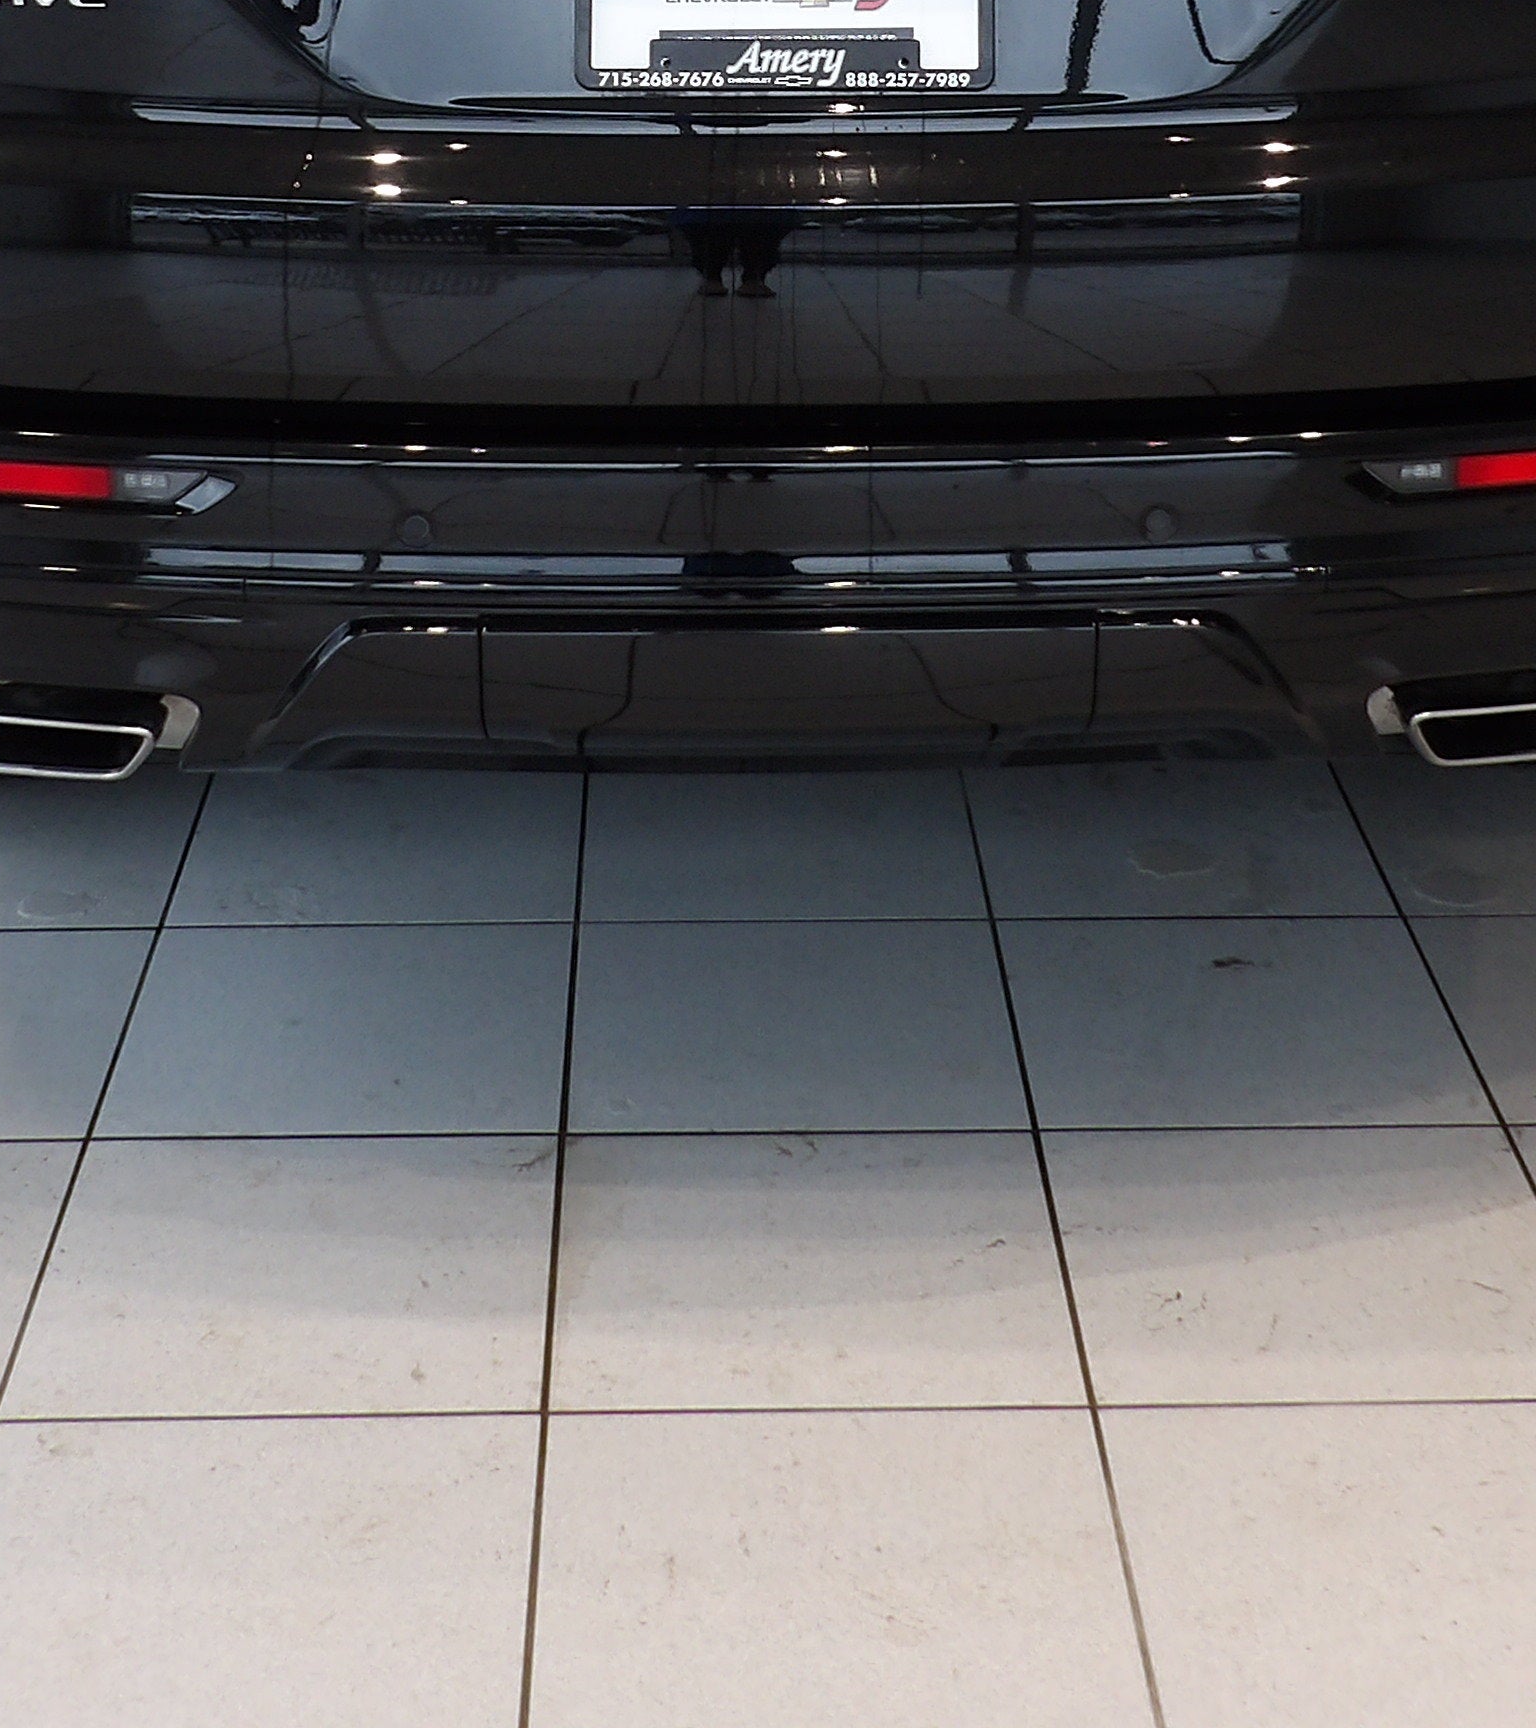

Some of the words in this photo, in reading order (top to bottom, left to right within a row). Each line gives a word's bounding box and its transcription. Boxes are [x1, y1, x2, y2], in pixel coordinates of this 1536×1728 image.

[726, 39, 846, 88] Amery
[598, 72, 724, 88] 715-268-7676
[845, 72, 971, 88] 888-257-7989
